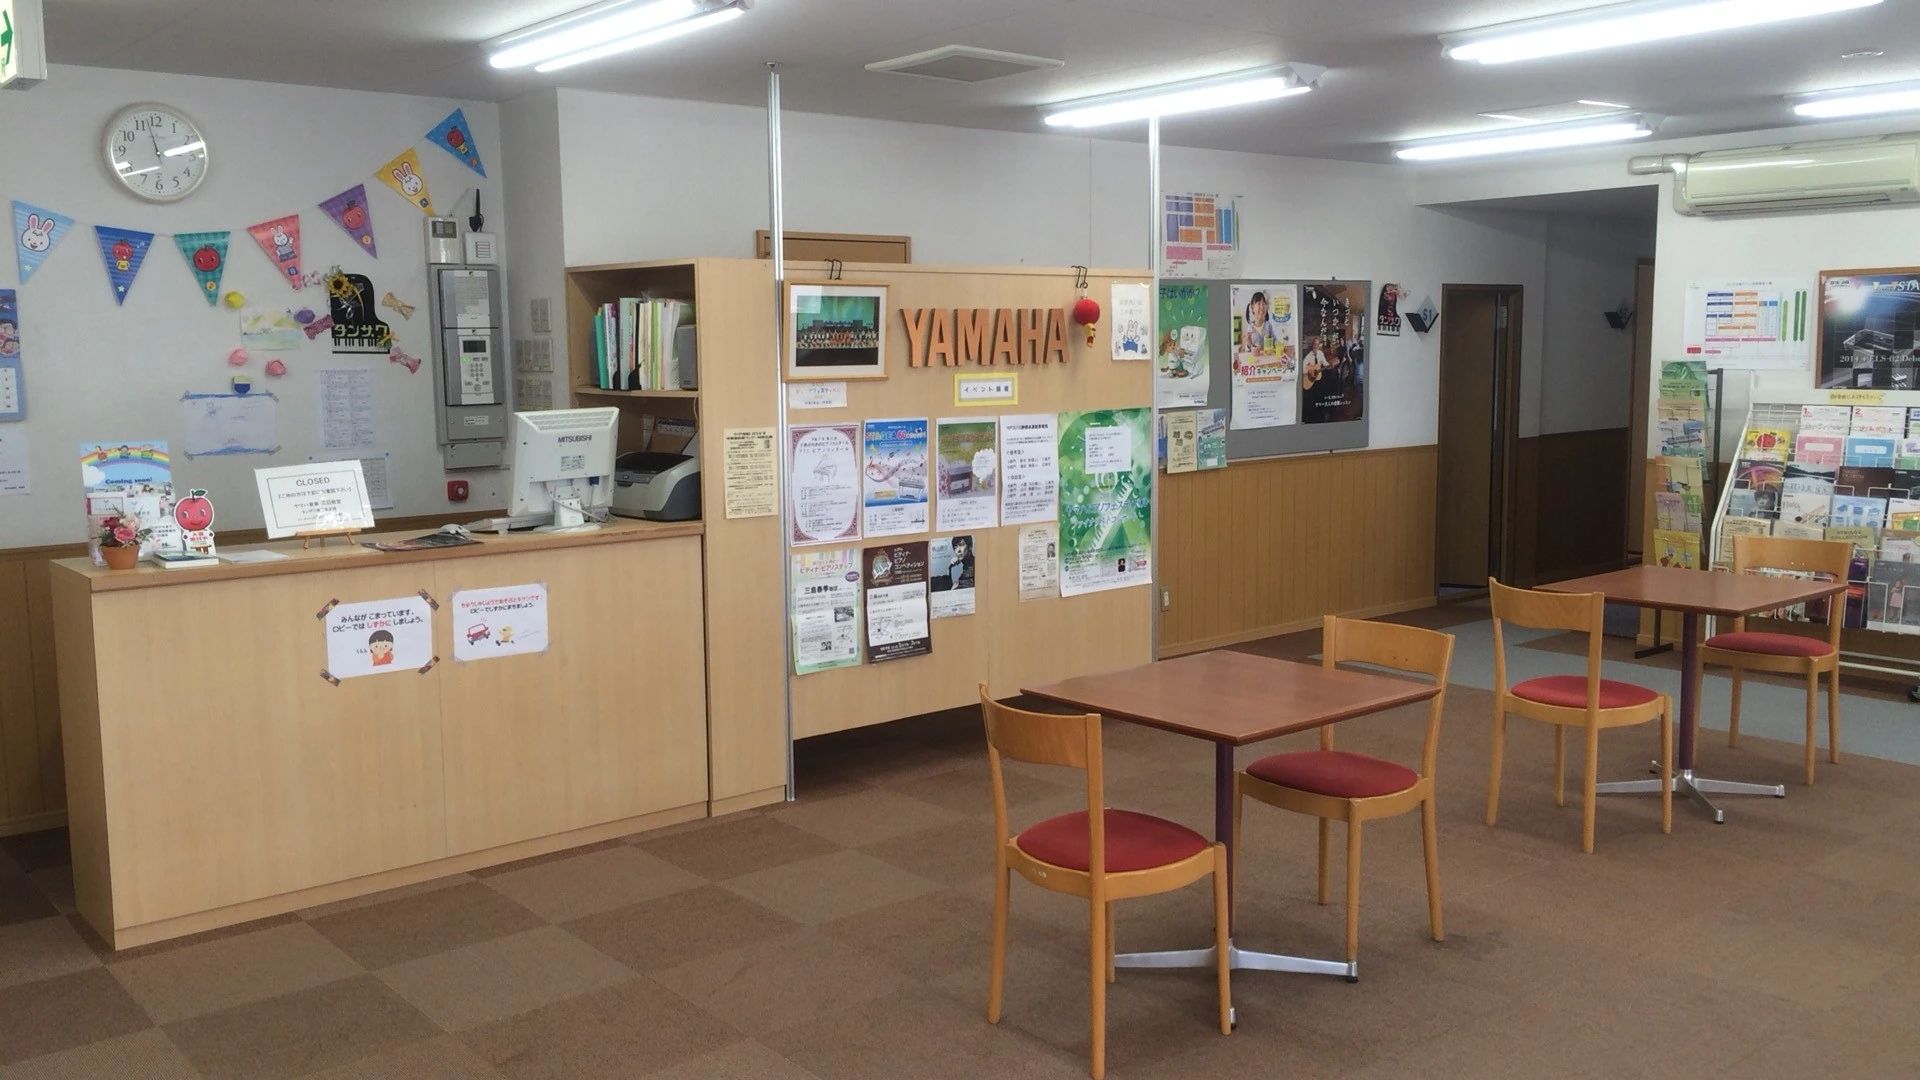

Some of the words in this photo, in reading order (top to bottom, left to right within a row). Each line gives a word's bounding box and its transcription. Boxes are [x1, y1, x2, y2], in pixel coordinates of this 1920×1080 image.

[135, 120, 146, 131] 11
[150, 116, 162, 127] 12
[172, 122, 176, 134] 1
[122, 130, 135, 142] 10
[118, 145, 126, 156] 9
[182, 166, 190, 177] 4
[140, 174, 148, 184] 7
[156, 179, 164, 190] 6
[172, 176, 180, 188] 5
[900, 307, 1070, 368] YAMAHA
[558, 434, 592, 443] MITSUBISHI
[296, 476, 330, 486] CLOSED
[341, 614, 367, 623] みんなが
[332, 623, 366, 632] ロビーでは
[366, 619, 392, 628] しずかに
